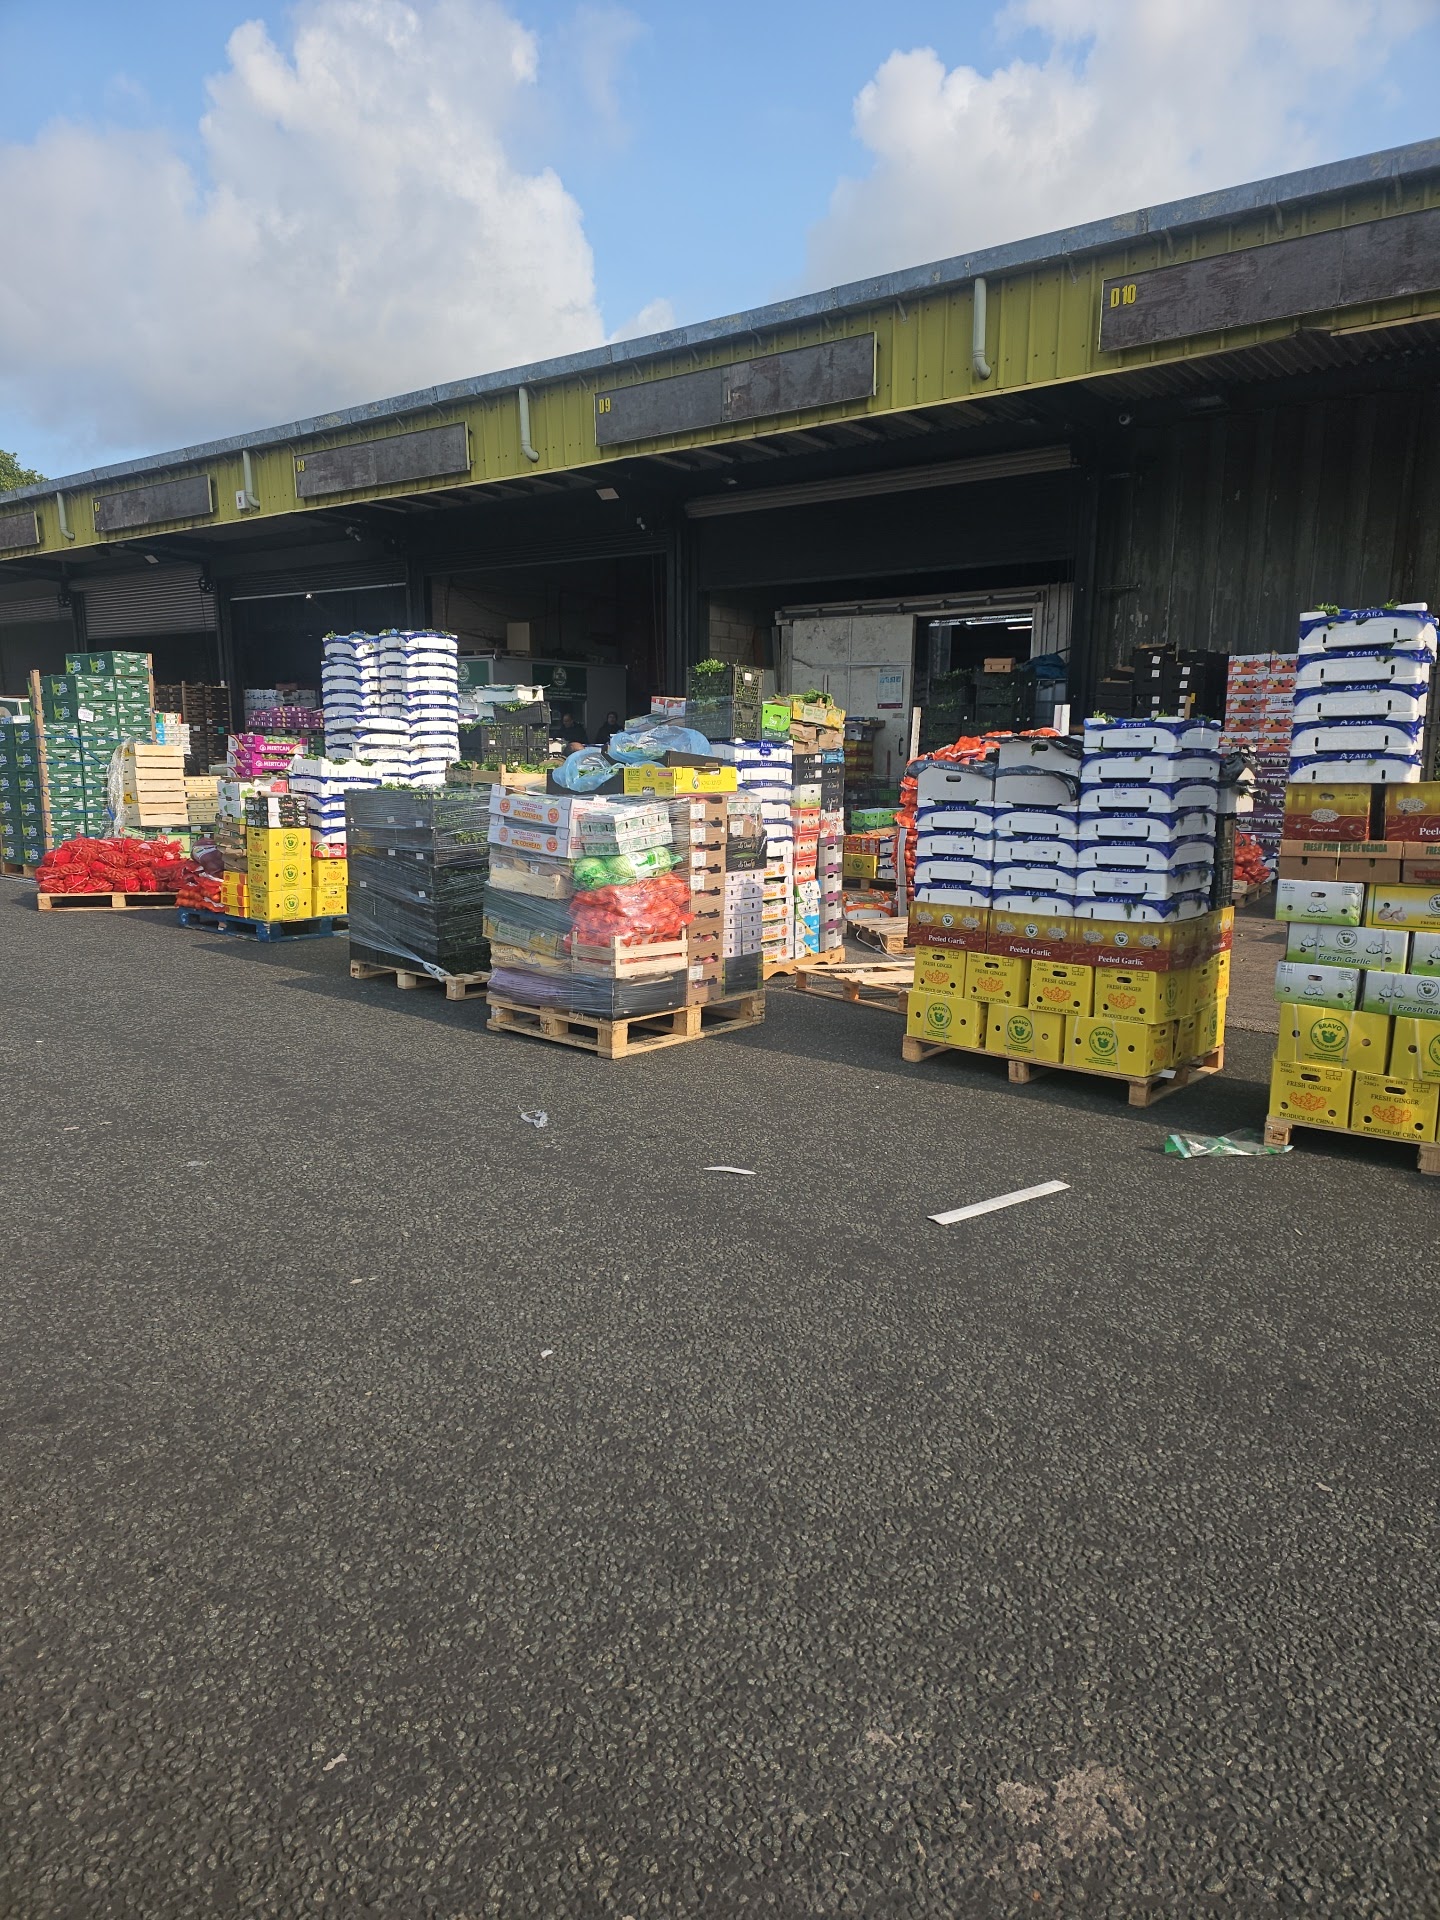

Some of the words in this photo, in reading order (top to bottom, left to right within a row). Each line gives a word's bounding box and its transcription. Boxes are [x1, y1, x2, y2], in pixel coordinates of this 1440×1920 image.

[599, 397, 610, 414] D9
[1350, 611, 1384, 620] AZARA
[1420, 828, 1440, 836] Peel
[1304, 842, 1322, 852] FRESH
[1353, 844, 1361, 852] OF
[1362, 844, 1388, 853] UGANDA
[928, 934, 947, 943] Peeled
[948, 936, 966, 945] Garlic
[1010, 946, 1030, 954] Peeled
[1031, 947, 1052, 957] Garlic
[1098, 956, 1120, 964] Peeled
[1122, 956, 1144, 966] Garlic
[1318, 953, 1343, 962] Fresh
[1345, 956, 1371, 965] Garlic
[1398, 1004, 1423, 1014] Fresh
[1318, 1023, 1342, 1032] BRAVO
[1286, 1080, 1306, 1088] FRESH
[1308, 1084, 1332, 1092] GINGER
[1370, 1094, 1392, 1102] FRESH
[1394, 1096, 1420, 1106] GINGER
[1280, 1112, 1306, 1120] PRODUCE
[1316, 1118, 1334, 1126] CHINA
[1364, 1126, 1392, 1136] PRODUCE
